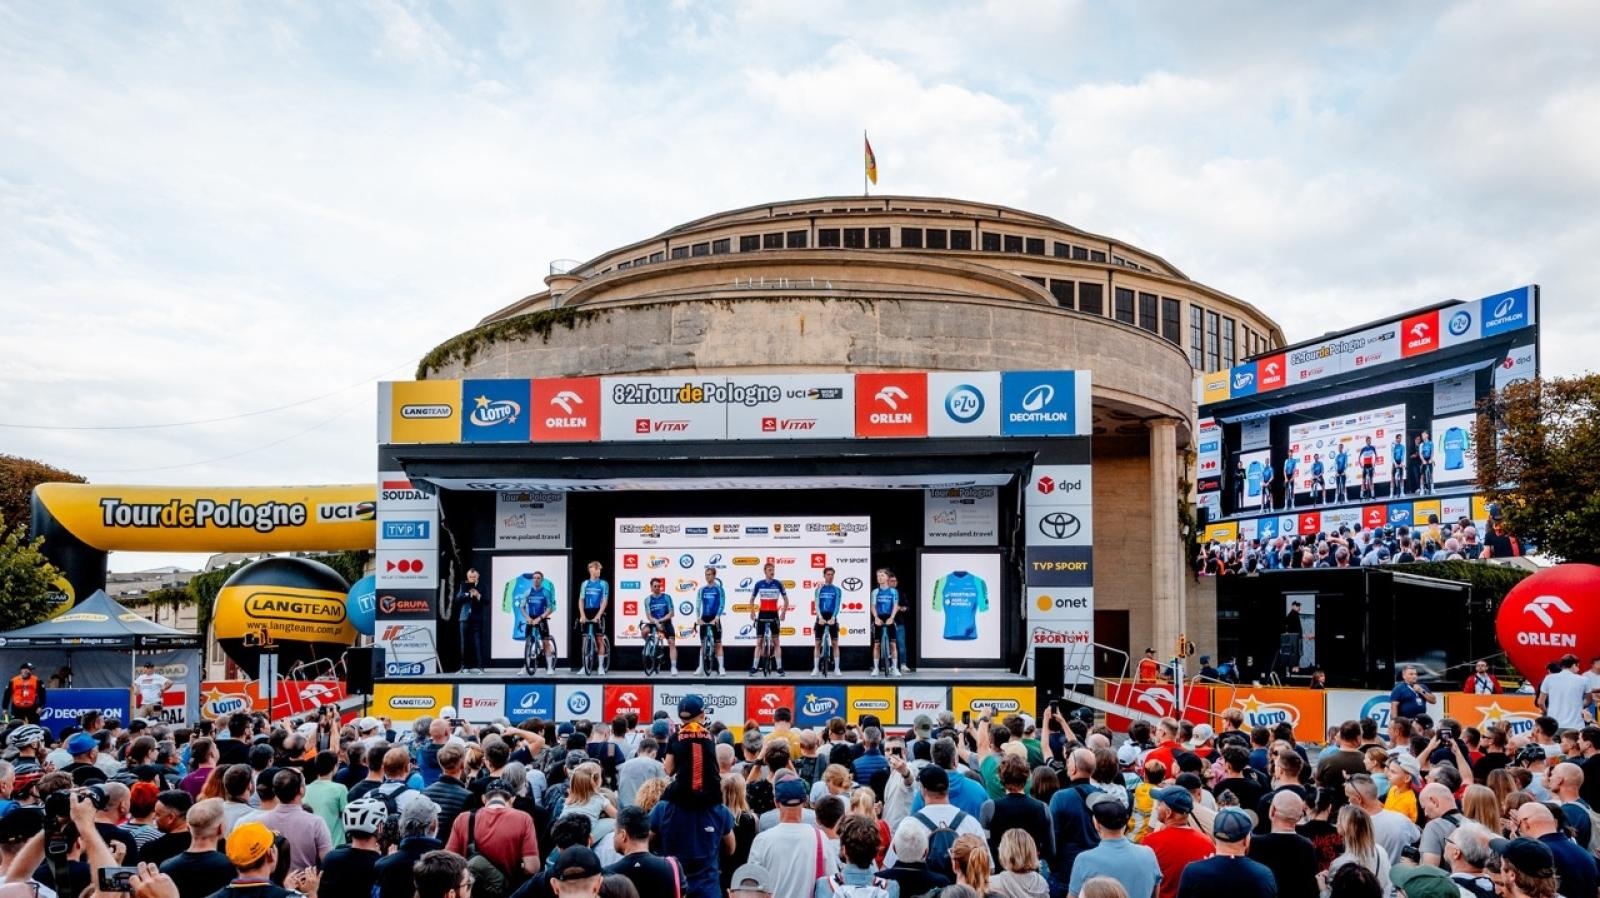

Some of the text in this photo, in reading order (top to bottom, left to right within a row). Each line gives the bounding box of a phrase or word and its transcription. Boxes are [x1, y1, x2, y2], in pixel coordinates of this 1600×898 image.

[787, 389, 806, 399] UCI
[953, 396, 976, 412] PZU
[404, 408, 449, 416] LANGTEAM
[1009, 413, 1067, 422] DECATHLON
[545, 417, 587, 428] ORLEN
[869, 413, 912, 424] ORLEN
[1059, 480, 1081, 493] dpd
[382, 490, 430, 500] SOUDAL
[101, 498, 352, 533] TourdePologne UCI
[1033, 562, 1088, 571] TVP SPORT
[252, 599, 341, 617] LANGTEAM
[396, 600, 429, 608] GRUPA
[1056, 597, 1087, 609] onet
[247, 621, 343, 636] www.langteam.com.pl
[1034, 634, 1089, 643] SPORTOWY
[1516, 631, 1577, 648] ORLEN
[212, 698, 242, 715] LOTTO
[572, 698, 586, 709] PZU
[1250, 711, 1286, 727] LOTTO
[1372, 709, 1390, 728] PZ
[1511, 719, 1533, 735] TTO
